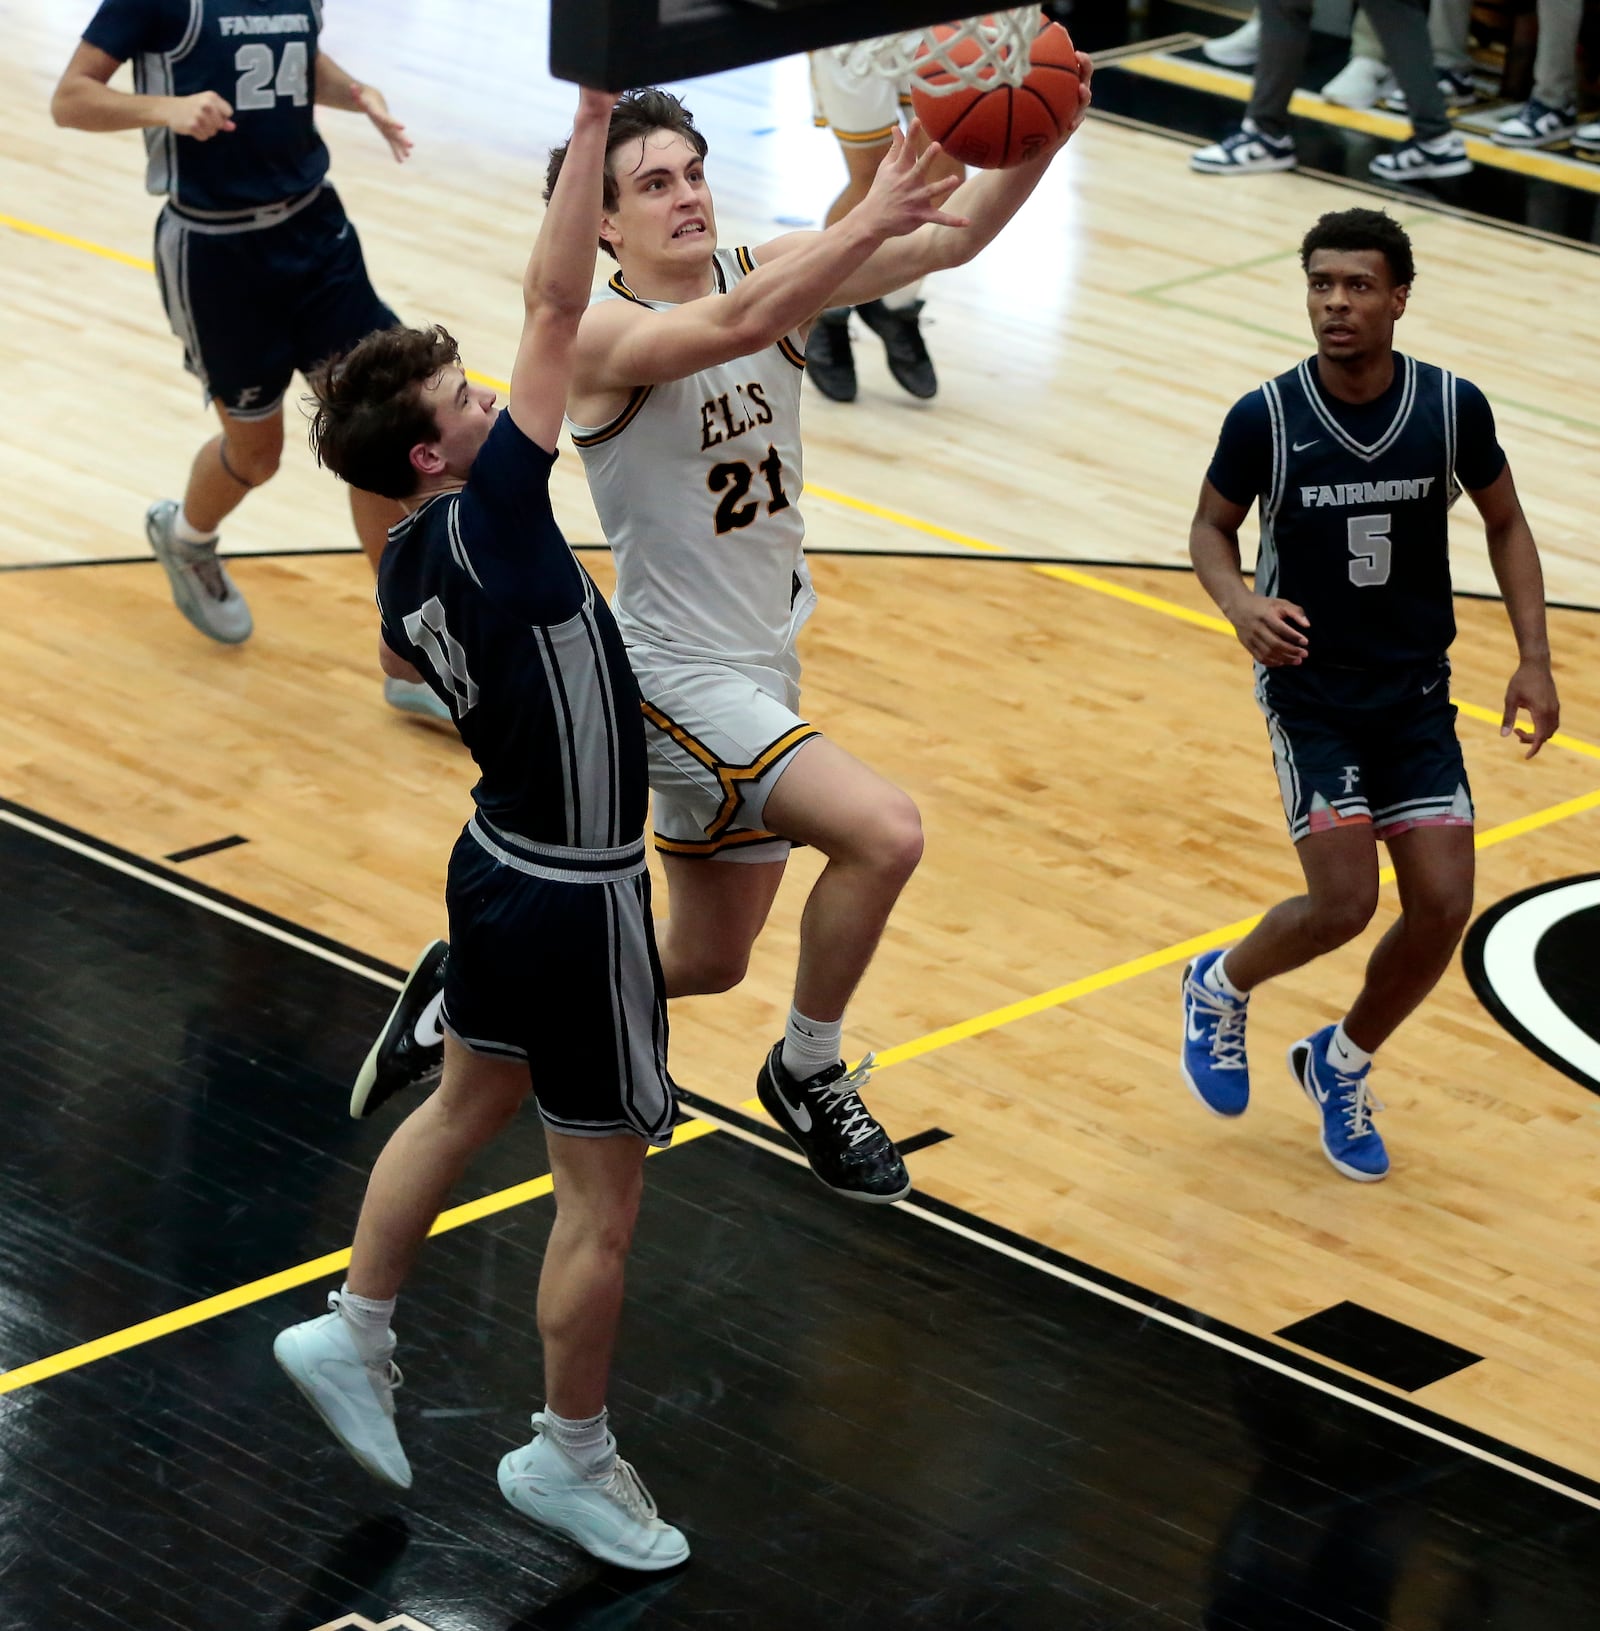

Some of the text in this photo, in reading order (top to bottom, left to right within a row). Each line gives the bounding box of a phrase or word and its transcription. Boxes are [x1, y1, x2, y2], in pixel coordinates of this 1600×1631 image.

[235, 41, 308, 110] 24
[701, 383, 773, 451] ELS
[706, 441, 790, 536] 21
[1299, 476, 1436, 508] FAIRMONT
[1347, 513, 1391, 587] 5
